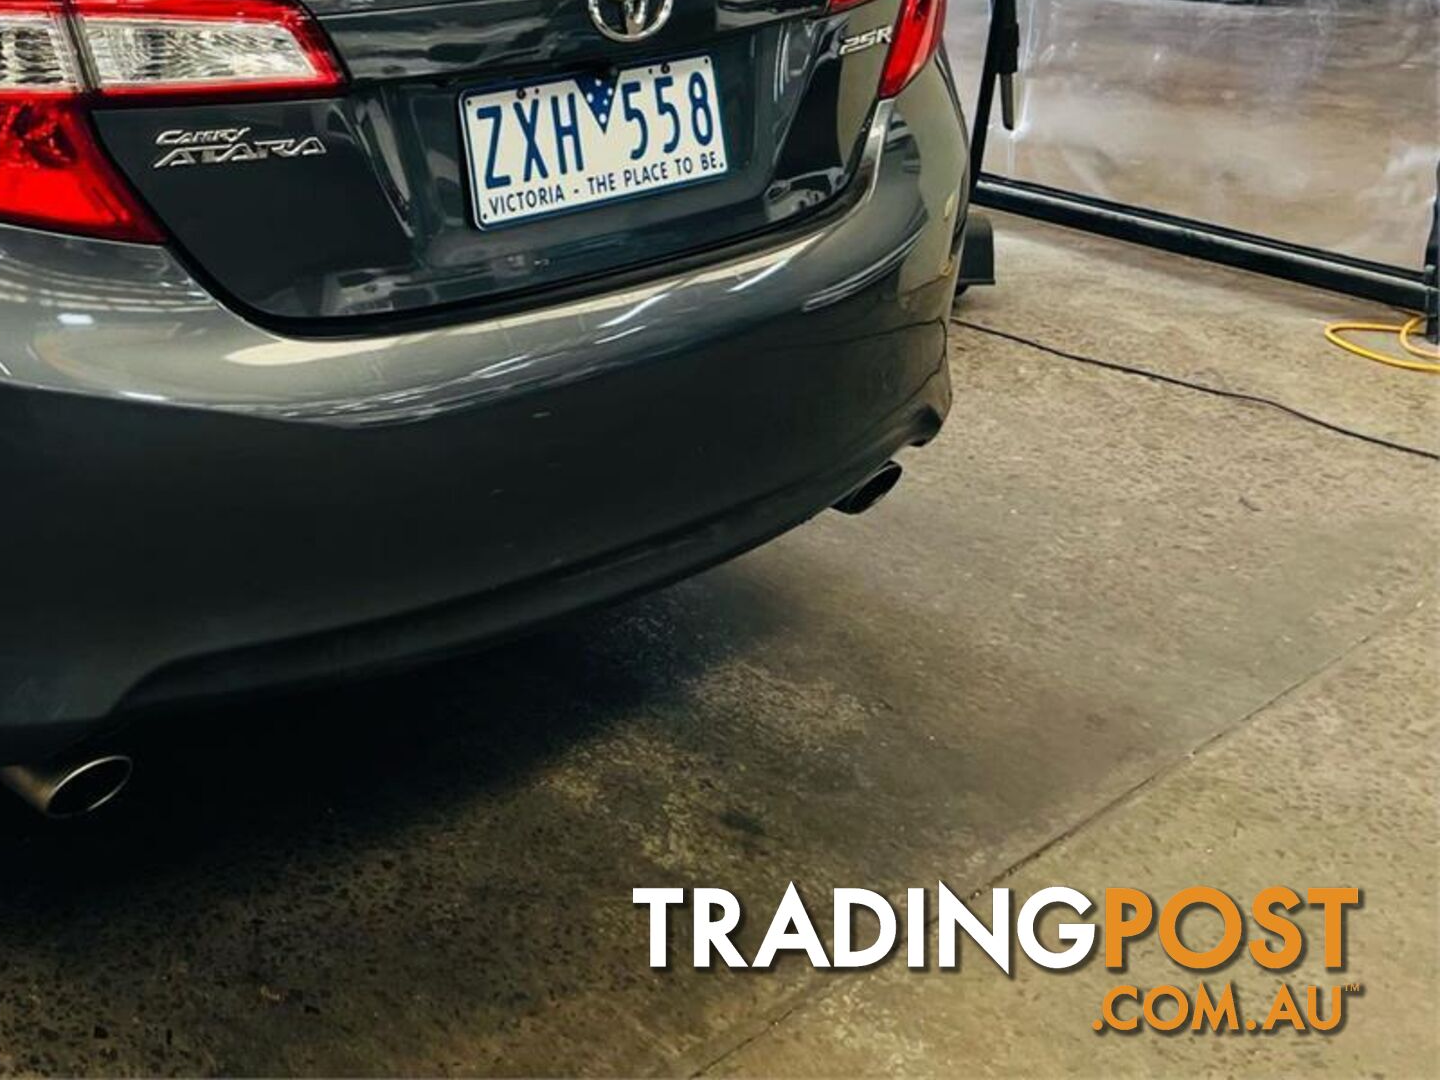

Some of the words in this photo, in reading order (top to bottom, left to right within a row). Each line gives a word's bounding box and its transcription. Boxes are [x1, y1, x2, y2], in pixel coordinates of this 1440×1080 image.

[153, 136, 327, 169] ATARA
[476, 92, 584, 190] ZXH
[621, 71, 714, 161] 558
[489, 184, 565, 217] VICTORIA
[587, 172, 616, 196] THE
[624, 160, 669, 187] PLACE
[676, 157, 693, 175] TO
[701, 150, 724, 171] BE.
